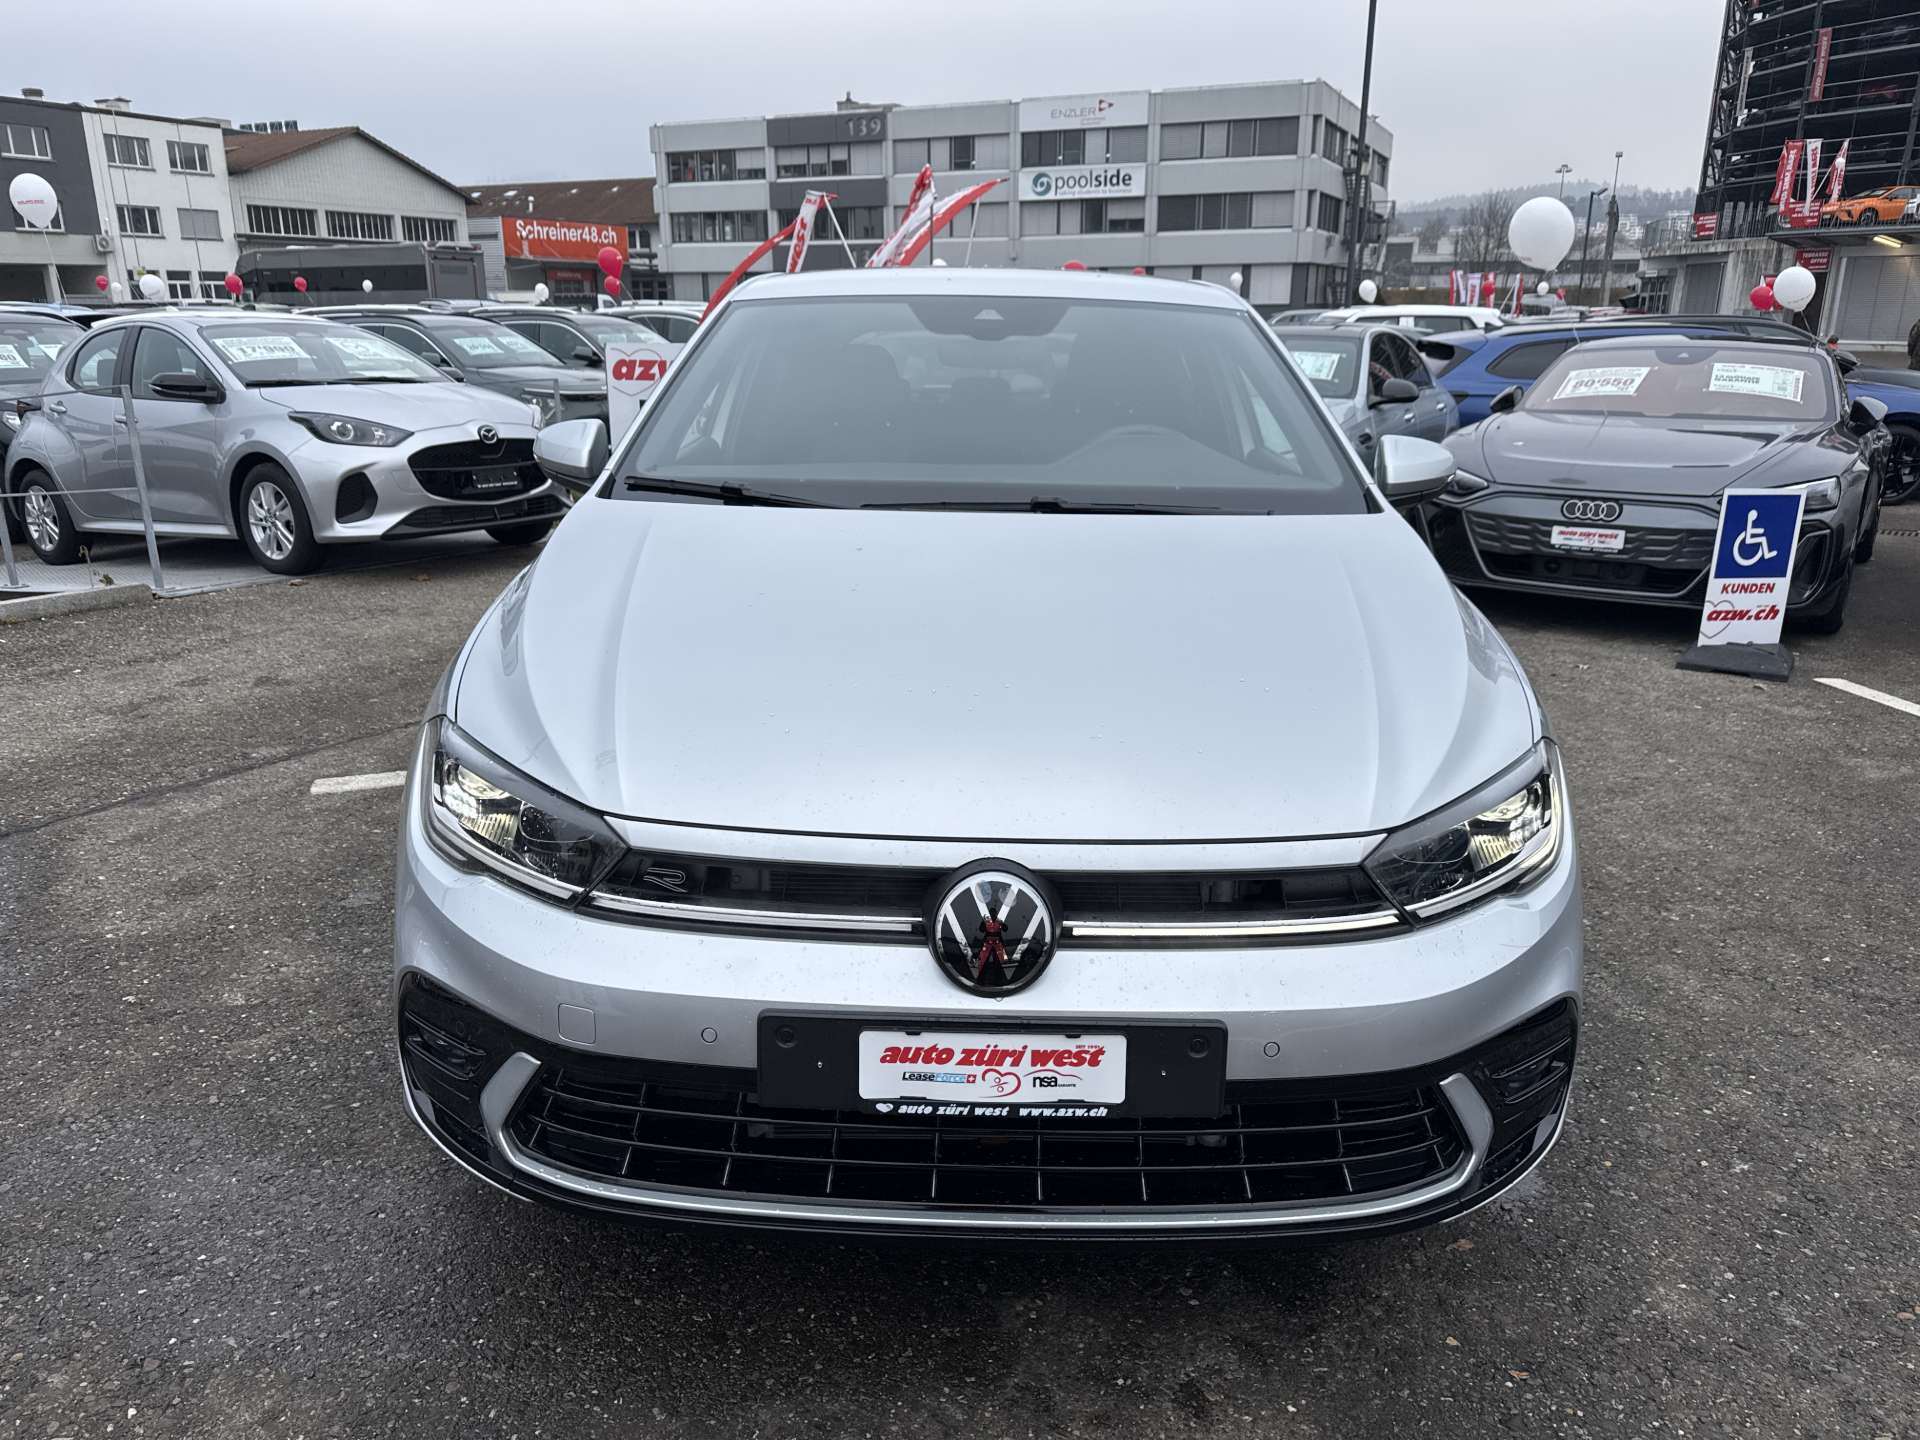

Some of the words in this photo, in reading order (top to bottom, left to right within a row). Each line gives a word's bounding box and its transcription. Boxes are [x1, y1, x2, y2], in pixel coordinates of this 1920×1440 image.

[1050, 106, 1097, 119] ENZLER
[848, 117, 881, 137] 139
[1055, 168, 1132, 196] poolside
[516, 219, 617, 244] Schreiner48.ch
[612, 358, 668, 382] az
[1721, 583, 1776, 594] KUNDEN
[1707, 605, 1779, 622] azw.ch
[879, 1043, 955, 1065] auto
[955, 1044, 1028, 1067] züri
[1030, 1046, 1106, 1067] west
[1032, 1076, 1058, 1088] nsa
[898, 1104, 933, 1115] auto
[936, 1103, 969, 1116] züri
[974, 1105, 1009, 1117] west
[1019, 1106, 1108, 1117] www.azw.ch
